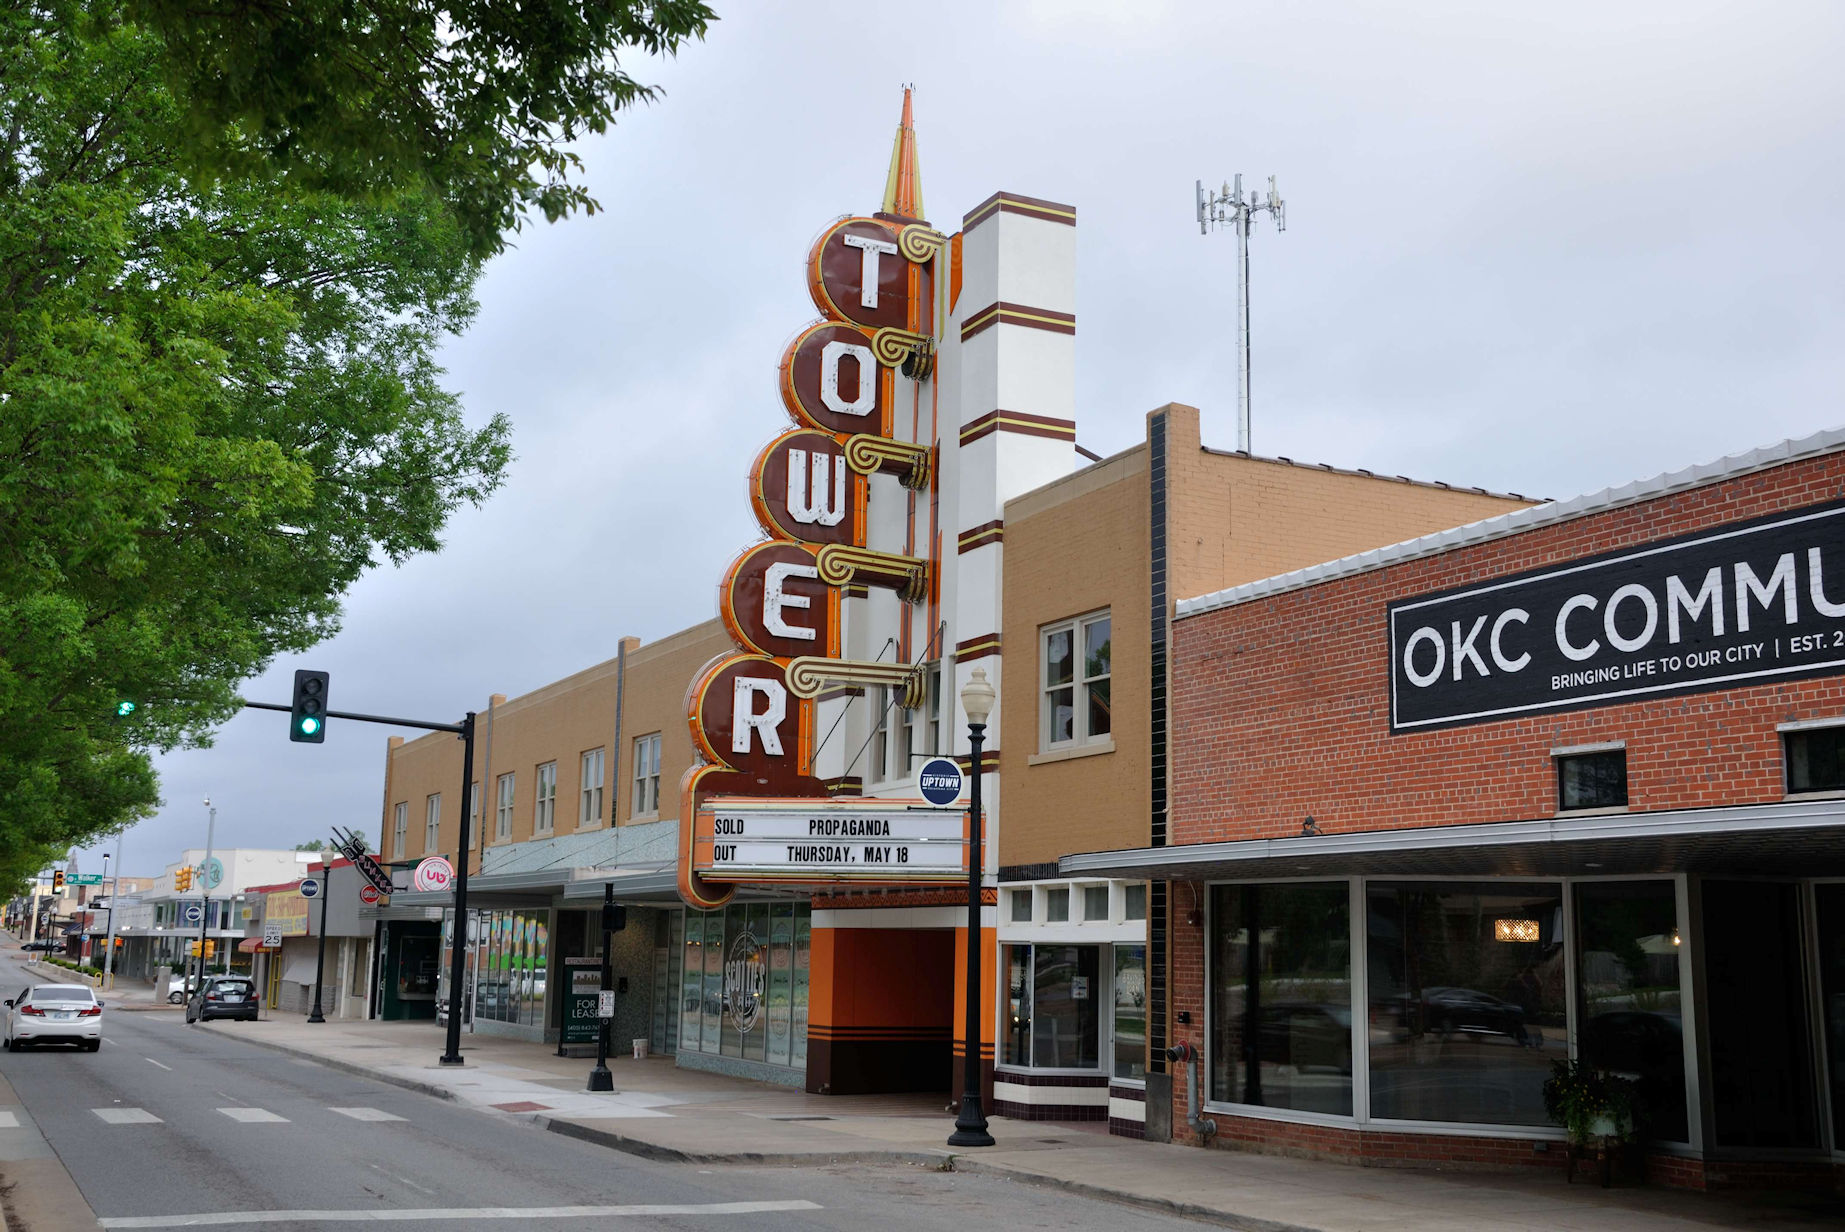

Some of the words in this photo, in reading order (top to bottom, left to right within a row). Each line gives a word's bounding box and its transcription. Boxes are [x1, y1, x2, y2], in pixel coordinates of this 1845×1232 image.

[731, 233, 898, 756] TOWER
[1403, 607, 1532, 688] OKC
[1551, 666, 1620, 690] BRINGING
[1624, 660, 1656, 679] LIFE
[1659, 656, 1681, 673] TO
[1685, 650, 1721, 667] OUR
[1725, 642, 1765, 662] CITY
[1790, 633, 1828, 653] EST.
[922, 777, 960, 788] UPTOWN
[714, 819, 744, 835] SOLD
[809, 819, 890, 836] PROPAGANDA
[713, 845, 737, 861] OUT
[787, 846, 856, 863] THURSDAY,
[864, 846, 891, 863] MAY
[896, 846, 909, 863] 18
[265, 935, 280, 945] 25
[576, 999, 596, 1009] FOR
[572, 1009, 600, 1019] LEASE
